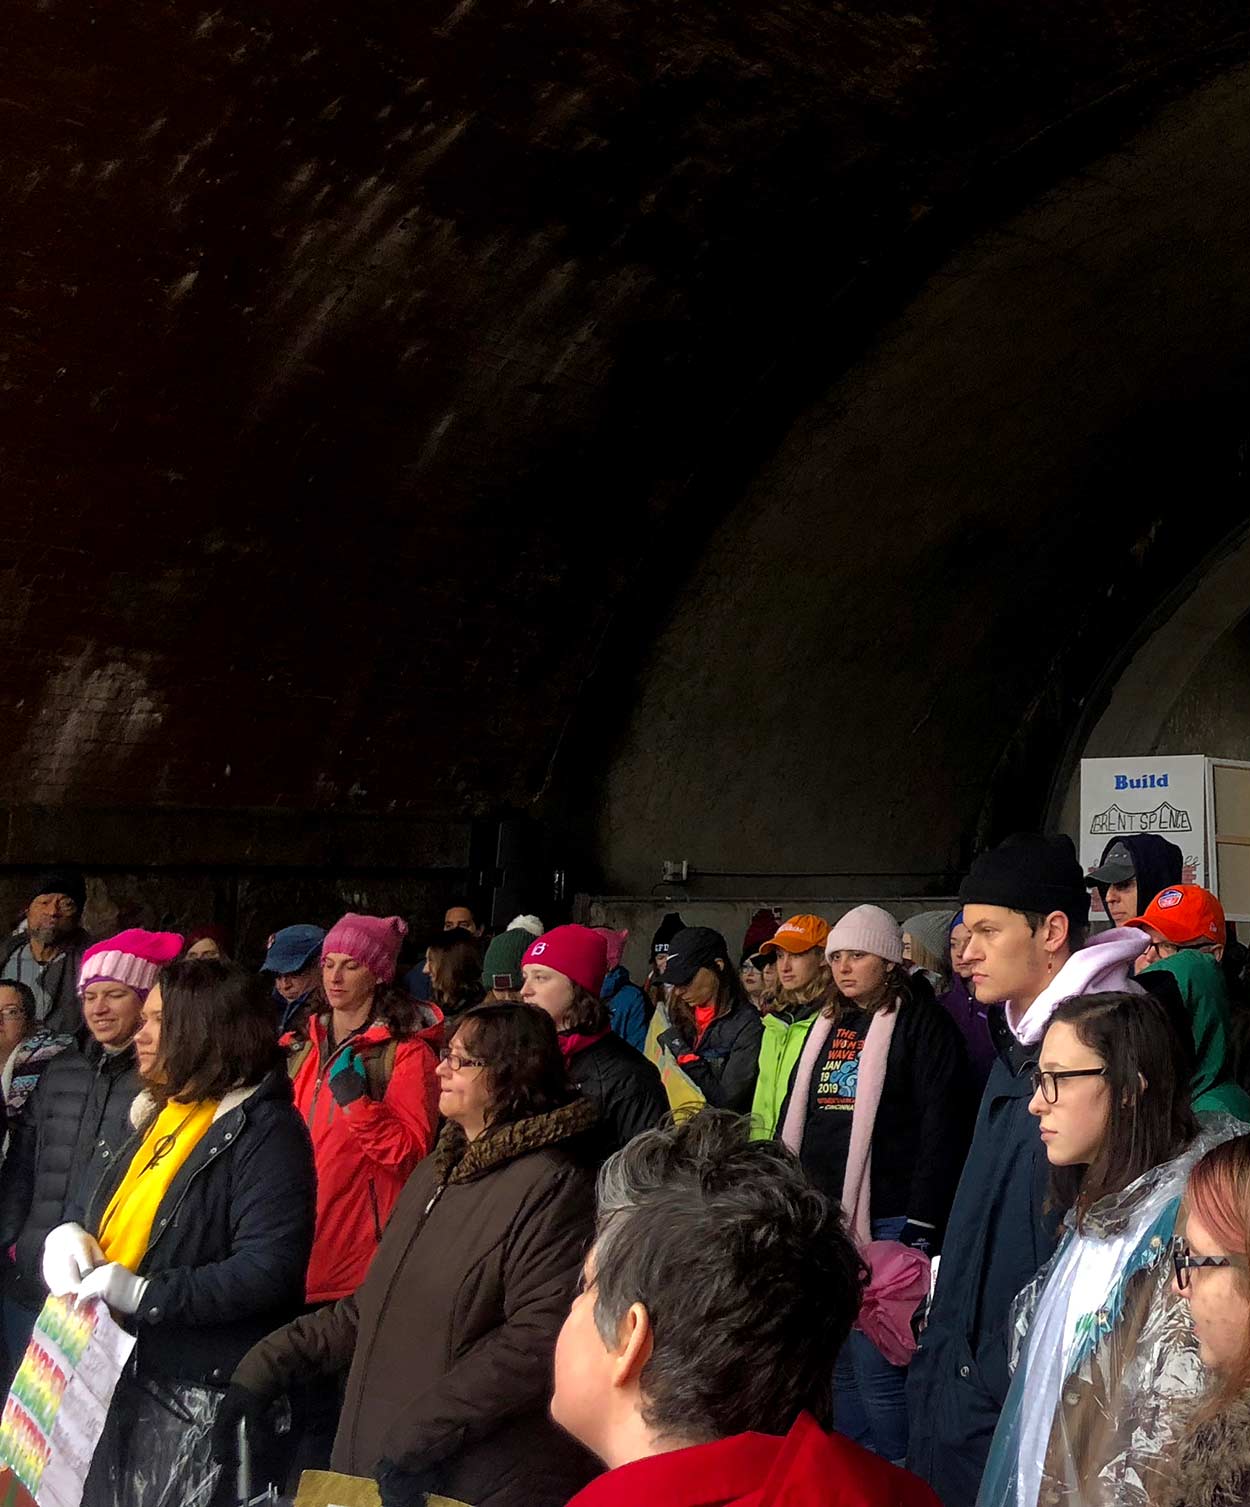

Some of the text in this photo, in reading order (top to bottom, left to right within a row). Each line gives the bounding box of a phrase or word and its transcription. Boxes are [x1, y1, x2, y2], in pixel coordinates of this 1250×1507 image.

[1114, 774, 1168, 790] Build
[1140, 804, 1189, 830] SPENCE
[836, 1028, 857, 1040] THE
[828, 1050, 856, 1060] WAVE
[822, 1060, 842, 1071] JAN
[820, 1072, 830, 1082] 19
[817, 1083, 838, 1094] 2019
